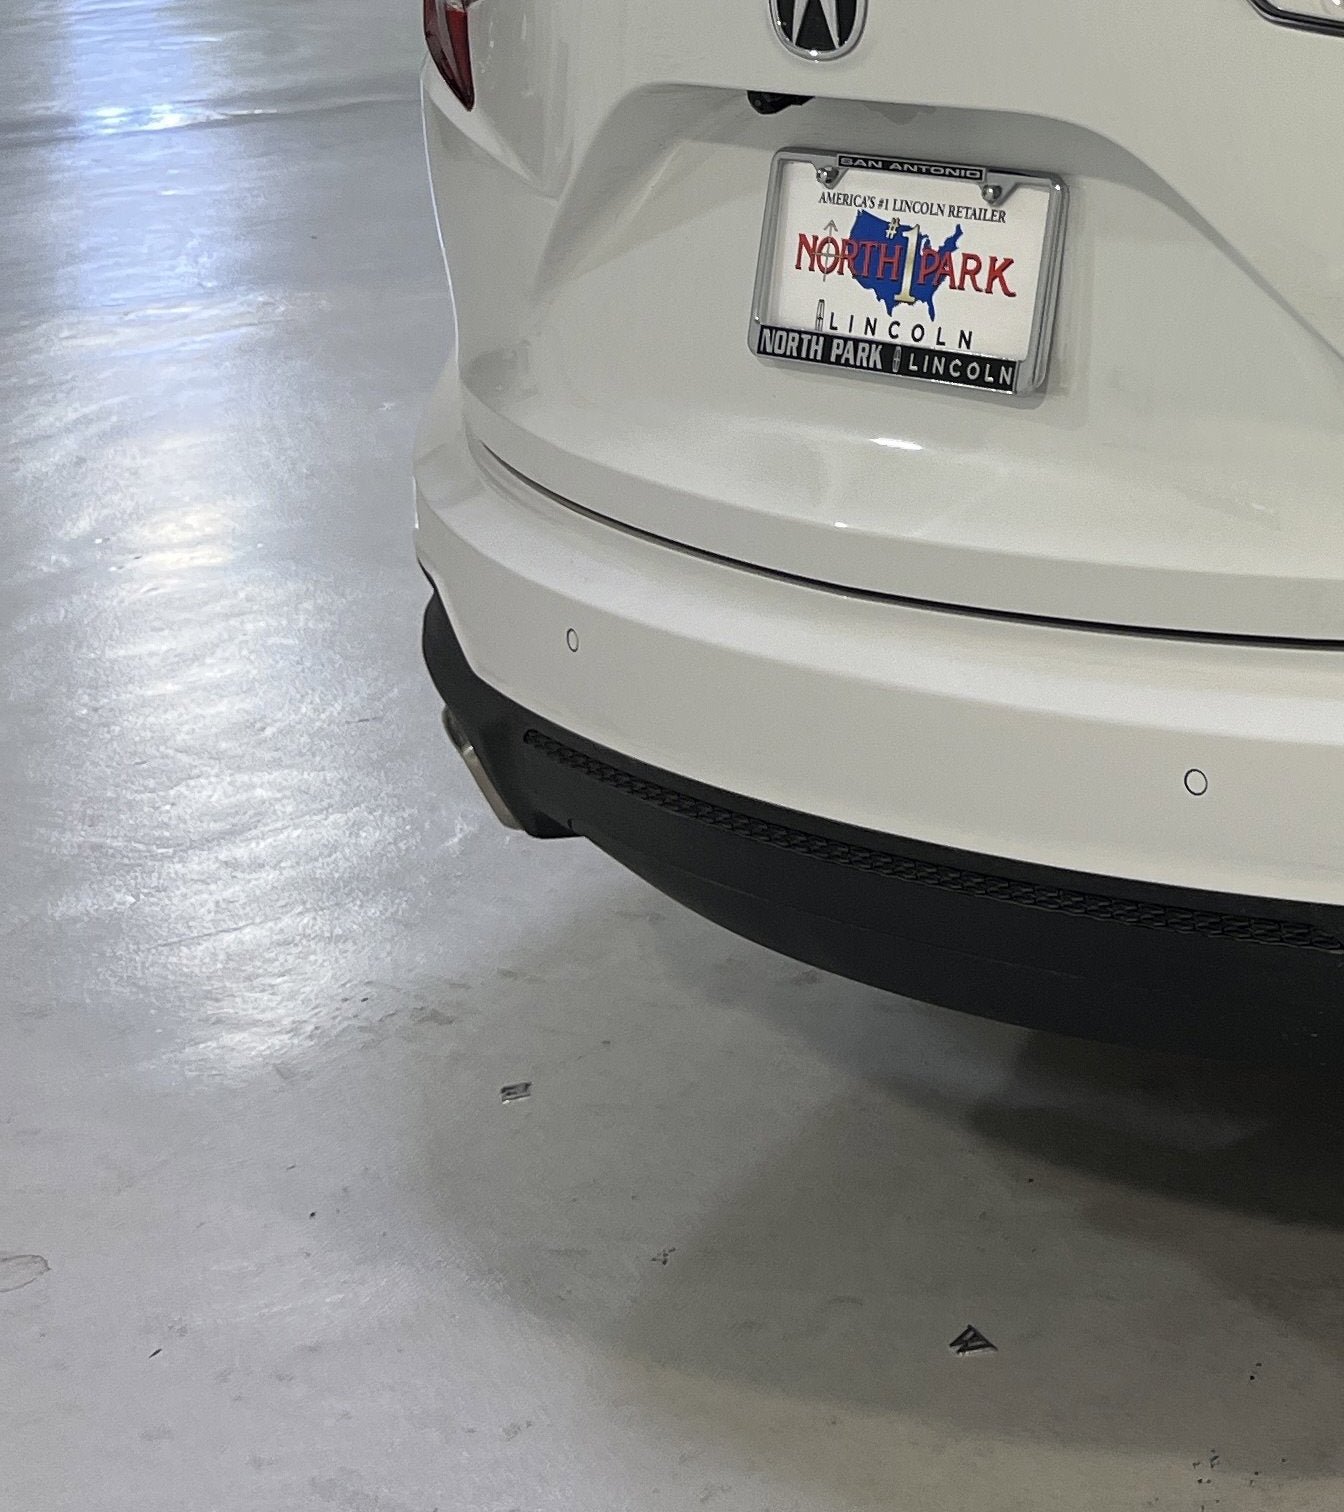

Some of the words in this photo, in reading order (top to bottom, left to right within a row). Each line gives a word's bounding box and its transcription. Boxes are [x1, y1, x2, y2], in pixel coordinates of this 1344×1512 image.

[838, 156, 884, 170] SAN
[888, 161, 981, 179] ANTONIO
[818, 191, 876, 209] AMERICA'S
[877, 197, 890, 211] #1
[892, 197, 945, 218] LINCOLN
[947, 204, 1007, 224] RETAILER
[795, 232, 903, 282] NORTH
[916, 246, 1017, 298] PARK
[829, 310, 973, 350] LINCOLN
[760, 327, 824, 361] NORTH
[829, 338, 884, 371] PARK
[909, 351, 1014, 386] LINCOLN
